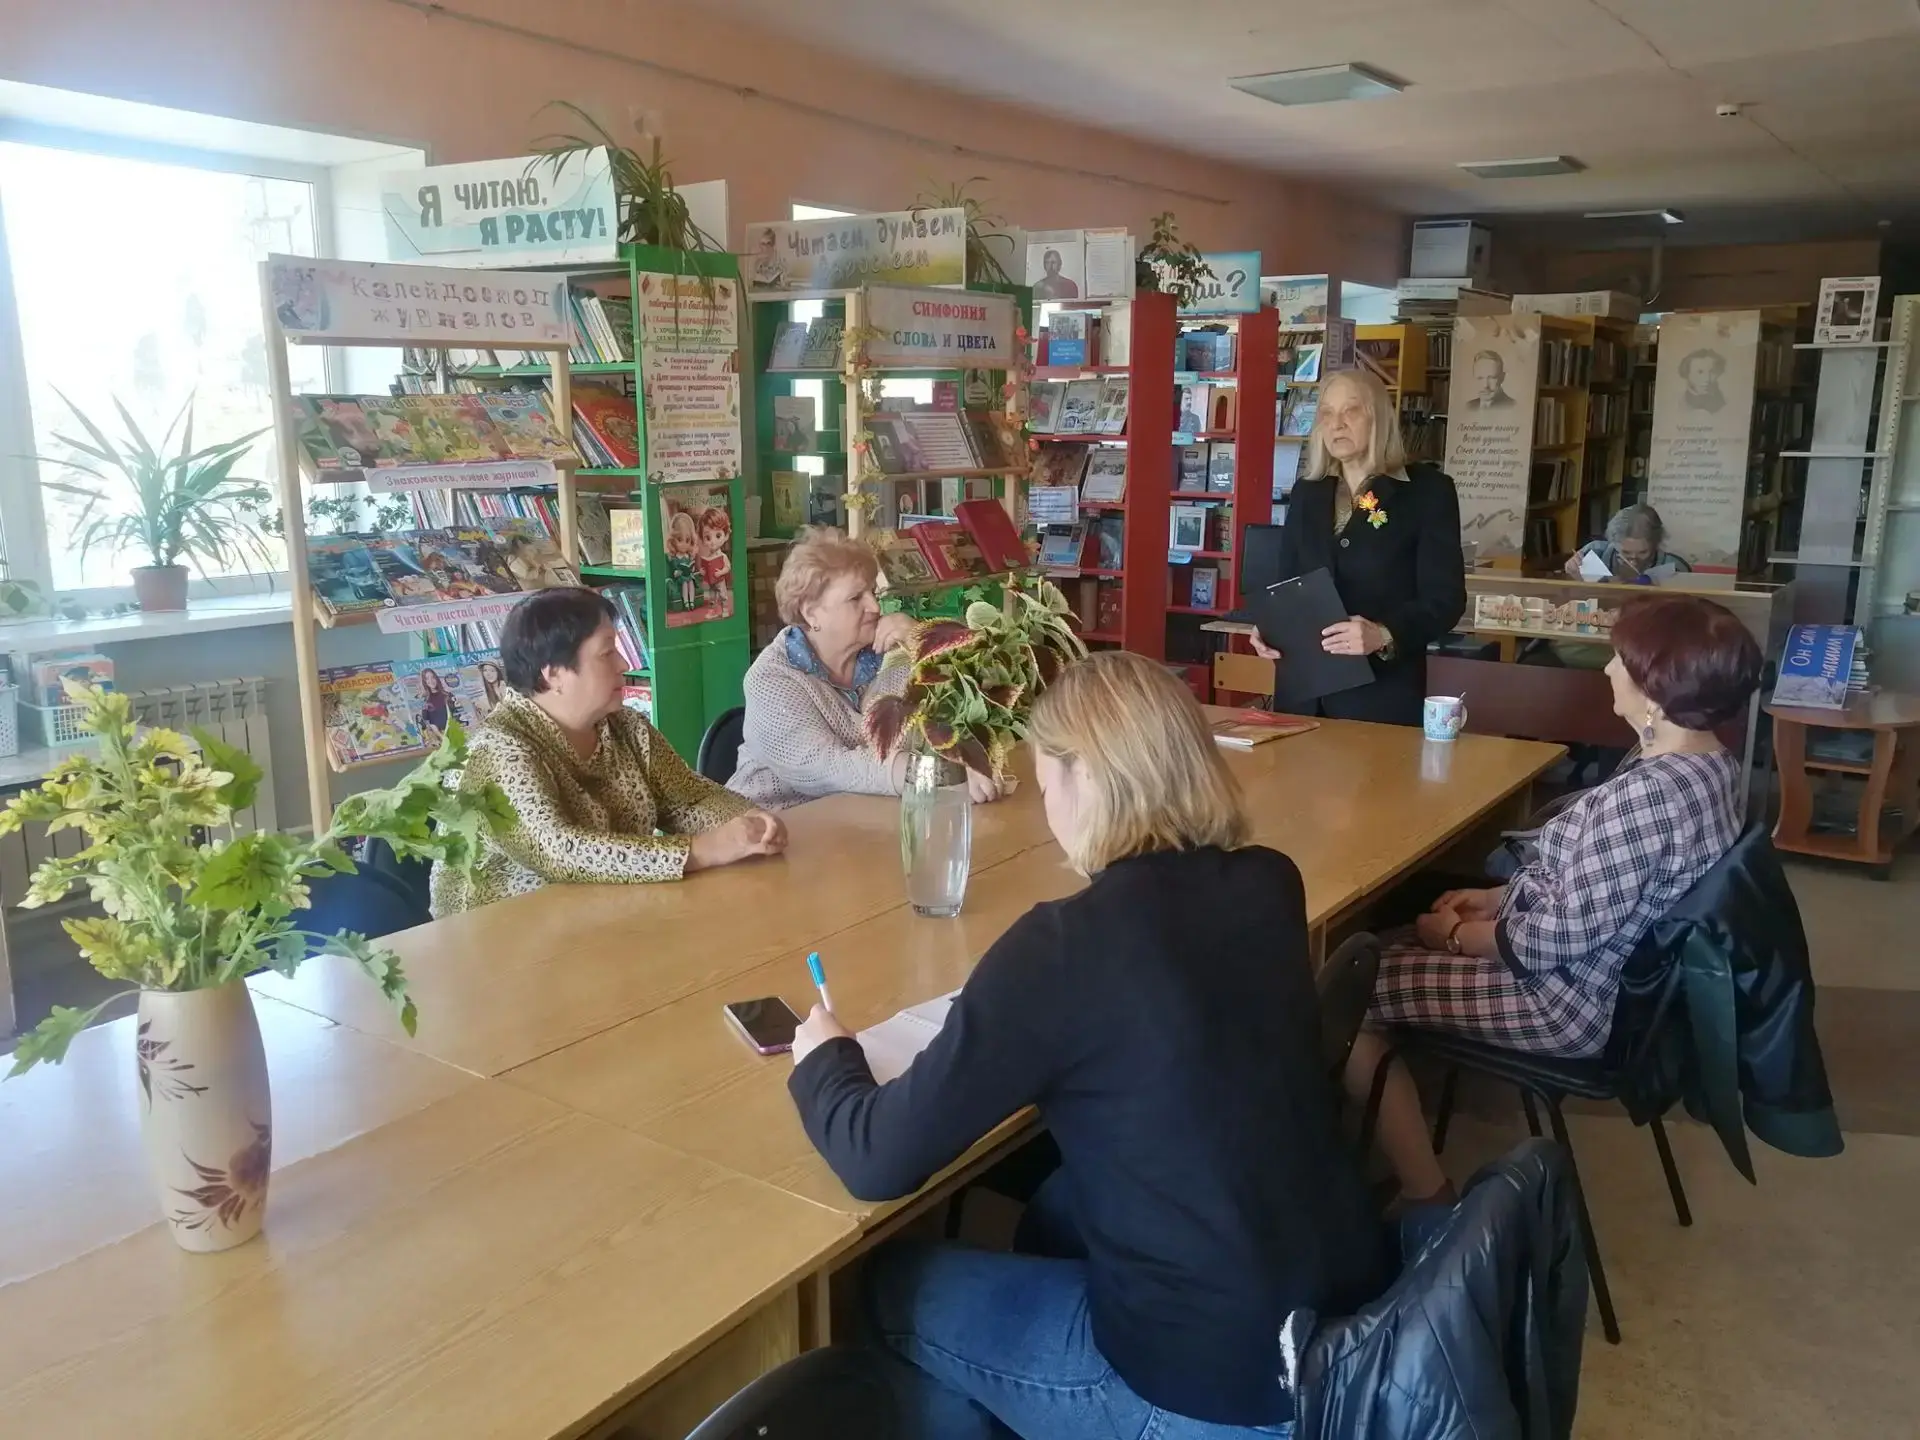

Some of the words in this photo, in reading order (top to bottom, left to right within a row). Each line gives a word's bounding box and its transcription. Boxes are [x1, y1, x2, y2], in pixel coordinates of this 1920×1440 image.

[418, 185, 443, 228] Я
[455, 178, 548, 208] ЧИТАЮ,
[480, 216, 500, 246] Я
[505, 208, 606, 244] РАСТУ!
[788, 229, 869, 257] Читаем,
[876, 216, 962, 251] думаем,
[912, 301, 987, 321] СИМФОНИЯ
[893, 332, 937, 348] СЛОВА
[942, 334, 952, 347] И
[957, 333, 997, 352] ЦВЕТА
